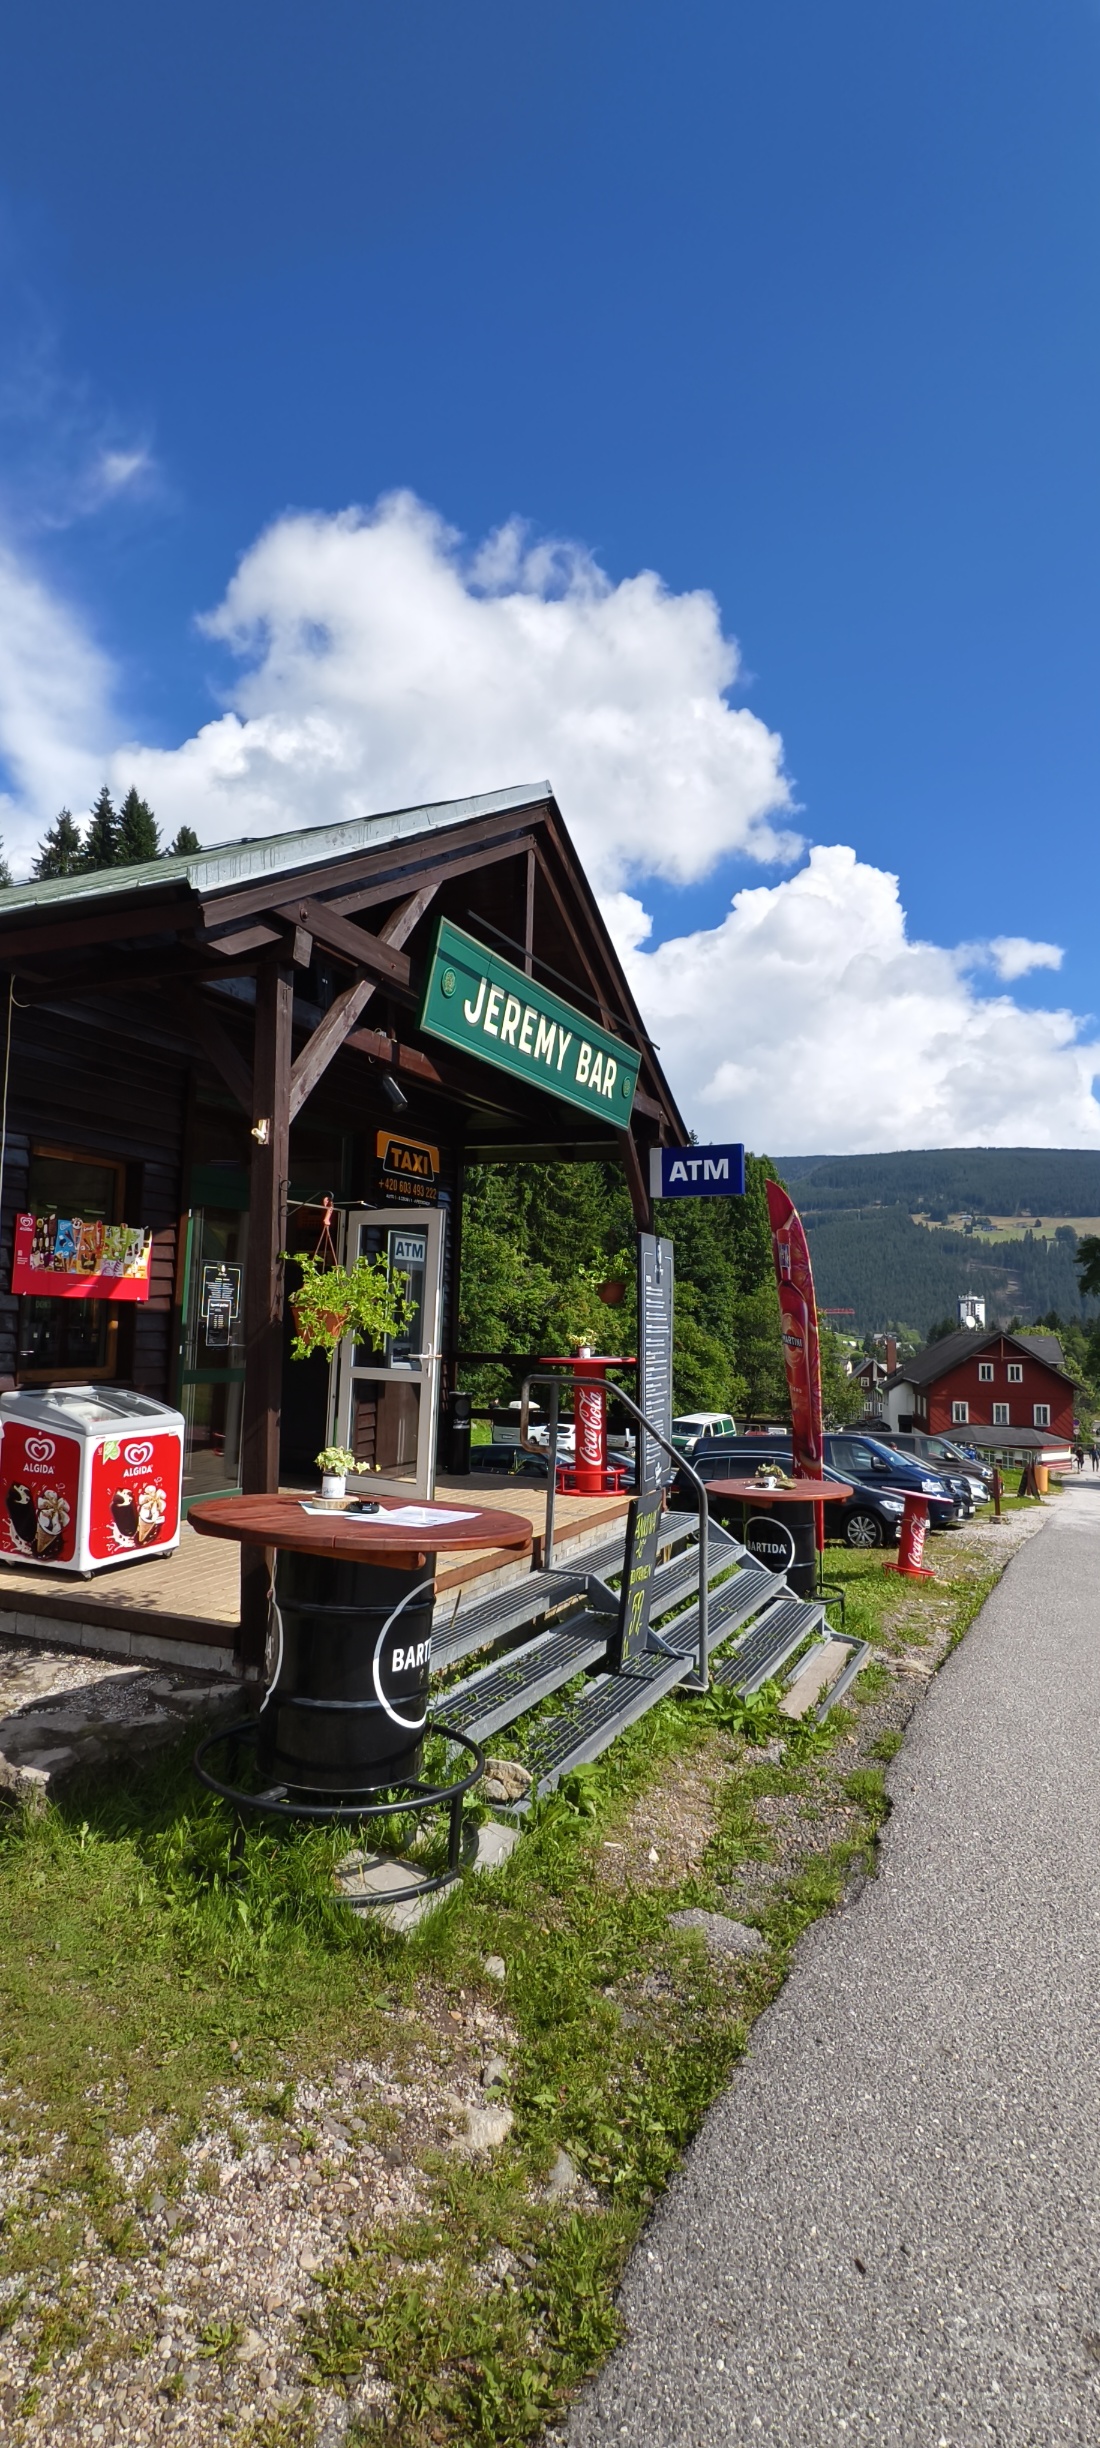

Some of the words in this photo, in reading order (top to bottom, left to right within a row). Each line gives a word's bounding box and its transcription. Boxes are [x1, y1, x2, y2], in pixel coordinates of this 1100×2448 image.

[464, 976, 573, 1072] JEREMY
[575, 1040, 618, 1100] BAR
[391, 1147, 428, 1175] TAXI
[669, 1158, 729, 1182] ATM
[378, 1177, 398, 1191] +420
[399, 1180, 412, 1194] 603
[412, 1183, 425, 1197] 493
[425, 1186, 437, 1200] 222
[395, 1241, 424, 1259] ATM
[22, 1463, 54, 1475] ALGIDA
[123, 1466, 152, 1478] ALGIDA
[747, 1539, 787, 1555] BARTIDA
